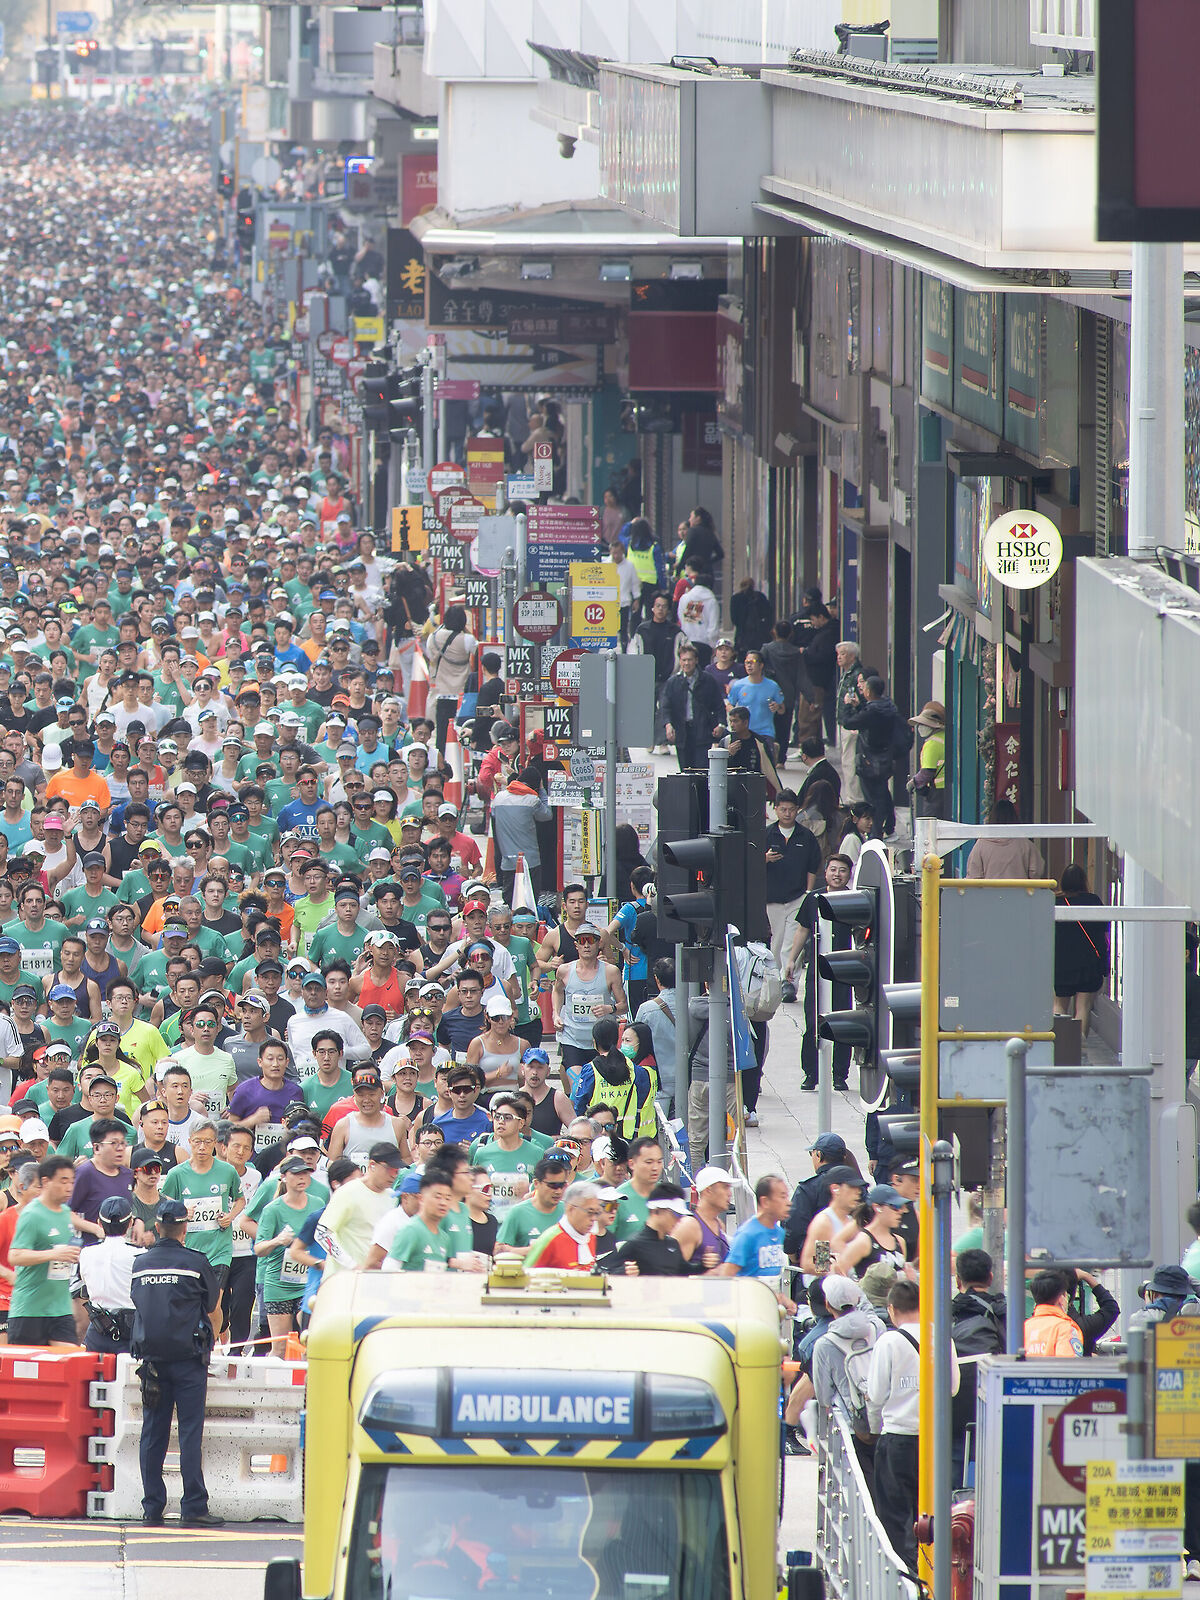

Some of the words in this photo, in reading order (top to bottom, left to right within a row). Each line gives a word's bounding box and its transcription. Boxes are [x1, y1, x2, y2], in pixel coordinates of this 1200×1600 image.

[401, 258, 425, 294] 老
[423, 519, 443, 530] 169
[430, 533, 449, 544] MK
[429, 545, 442, 556] 17
[443, 547, 463, 557] MK
[996, 541, 1051, 557] HSBC
[442, 559, 465, 569] 171
[468, 581, 488, 593] MK
[467, 595, 489, 606] 172
[586, 608, 604, 620] H2
[508, 647, 530, 660] MK
[507, 662, 532, 675] 173
[521, 682, 534, 692] 3C
[547, 708, 570, 722] MK
[546, 724, 571, 737] 174
[587, 746, 606, 756] 元朗
[1004, 735, 1020, 804] 余仁生
[22, 960, 52, 969] E1812
[573, 1004, 591, 1015] E37
[299, 1066, 316, 1077] E48
[256, 1134, 283, 1146] E66
[493, 1186, 514, 1197] E65
[285, 1262, 309, 1274] E40
[145, 1275, 172, 1285] POLICE
[1159, 1371, 1183, 1389] 20A
[457, 1394, 630, 1424] AMBULANCE
[1073, 1419, 1098, 1437] 67X
[1092, 1465, 1112, 1477] 20A
[1107, 1506, 1179, 1519] 香港兒童醫院
[1042, 1508, 1086, 1535] MK
[1091, 1537, 1111, 1548] 20A
[1040, 1538, 1086, 1565] 175
